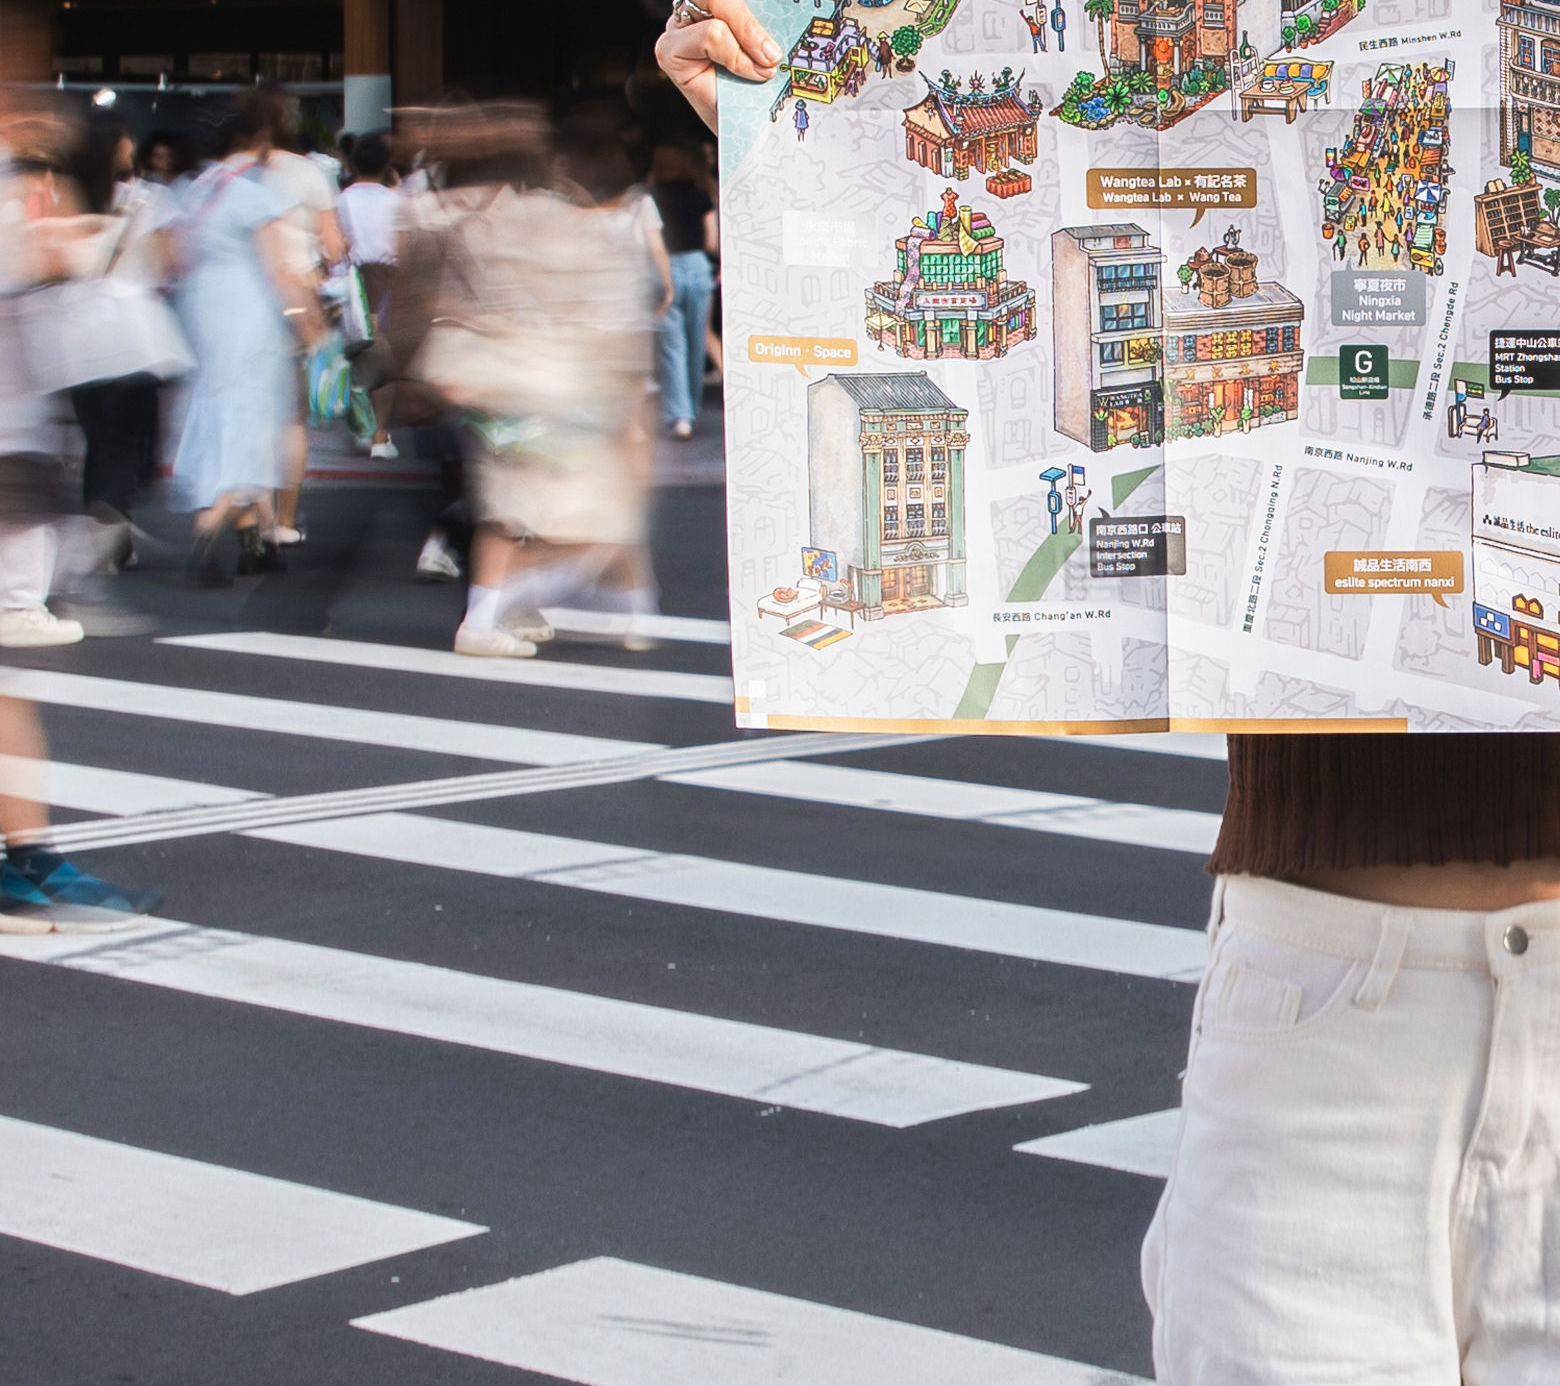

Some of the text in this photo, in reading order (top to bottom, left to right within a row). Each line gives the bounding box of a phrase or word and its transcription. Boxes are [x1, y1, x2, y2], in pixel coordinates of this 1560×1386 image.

[1401, 34, 1437, 45] Minshen
[1100, 176, 1155, 190] Wangtea
[1159, 176, 1181, 187] Lab
[1103, 192, 1241, 203] Wangtea Lab Wang Tea
[1359, 295, 1401, 308] Ningxia
[1342, 309, 1415, 323] Night Market
[814, 345, 852, 359] Space
[1495, 352, 1515, 362] MRT
[1355, 350, 1373, 374] G
[1495, 363, 1526, 373] Station
[1495, 374, 1534, 385] Bus Stop
[1346, 453, 1384, 468] Nanjing
[1387, 459, 1413, 471] W.Rd
[1526, 524, 1539, 536] the
[1096, 538, 1155, 550] Nanjing W.Rd
[1096, 550, 1148, 560] Intersection
[1097, 561, 1136, 572] Bus Stop
[1335, 576, 1454, 589] eslite spectrum nanxi
[1085, 609, 1112, 620] W.Rd
